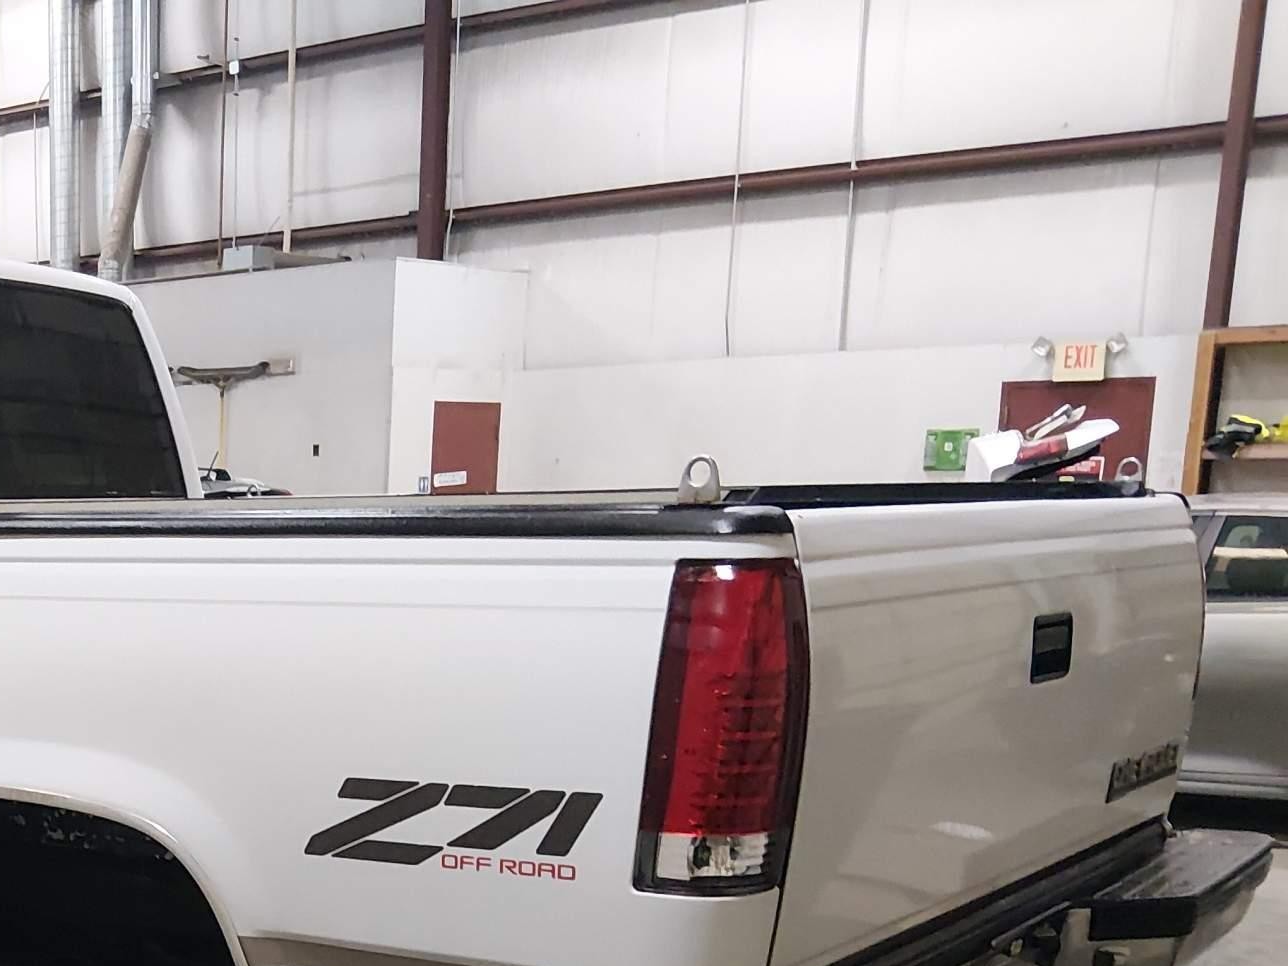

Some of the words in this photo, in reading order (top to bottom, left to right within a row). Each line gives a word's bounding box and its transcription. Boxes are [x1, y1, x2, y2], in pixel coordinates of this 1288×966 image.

[1064, 344, 1098, 369] EXIT
[304, 777, 604, 866] Z71
[440, 854, 491, 872] OFF
[498, 858, 577, 881] ROAD
